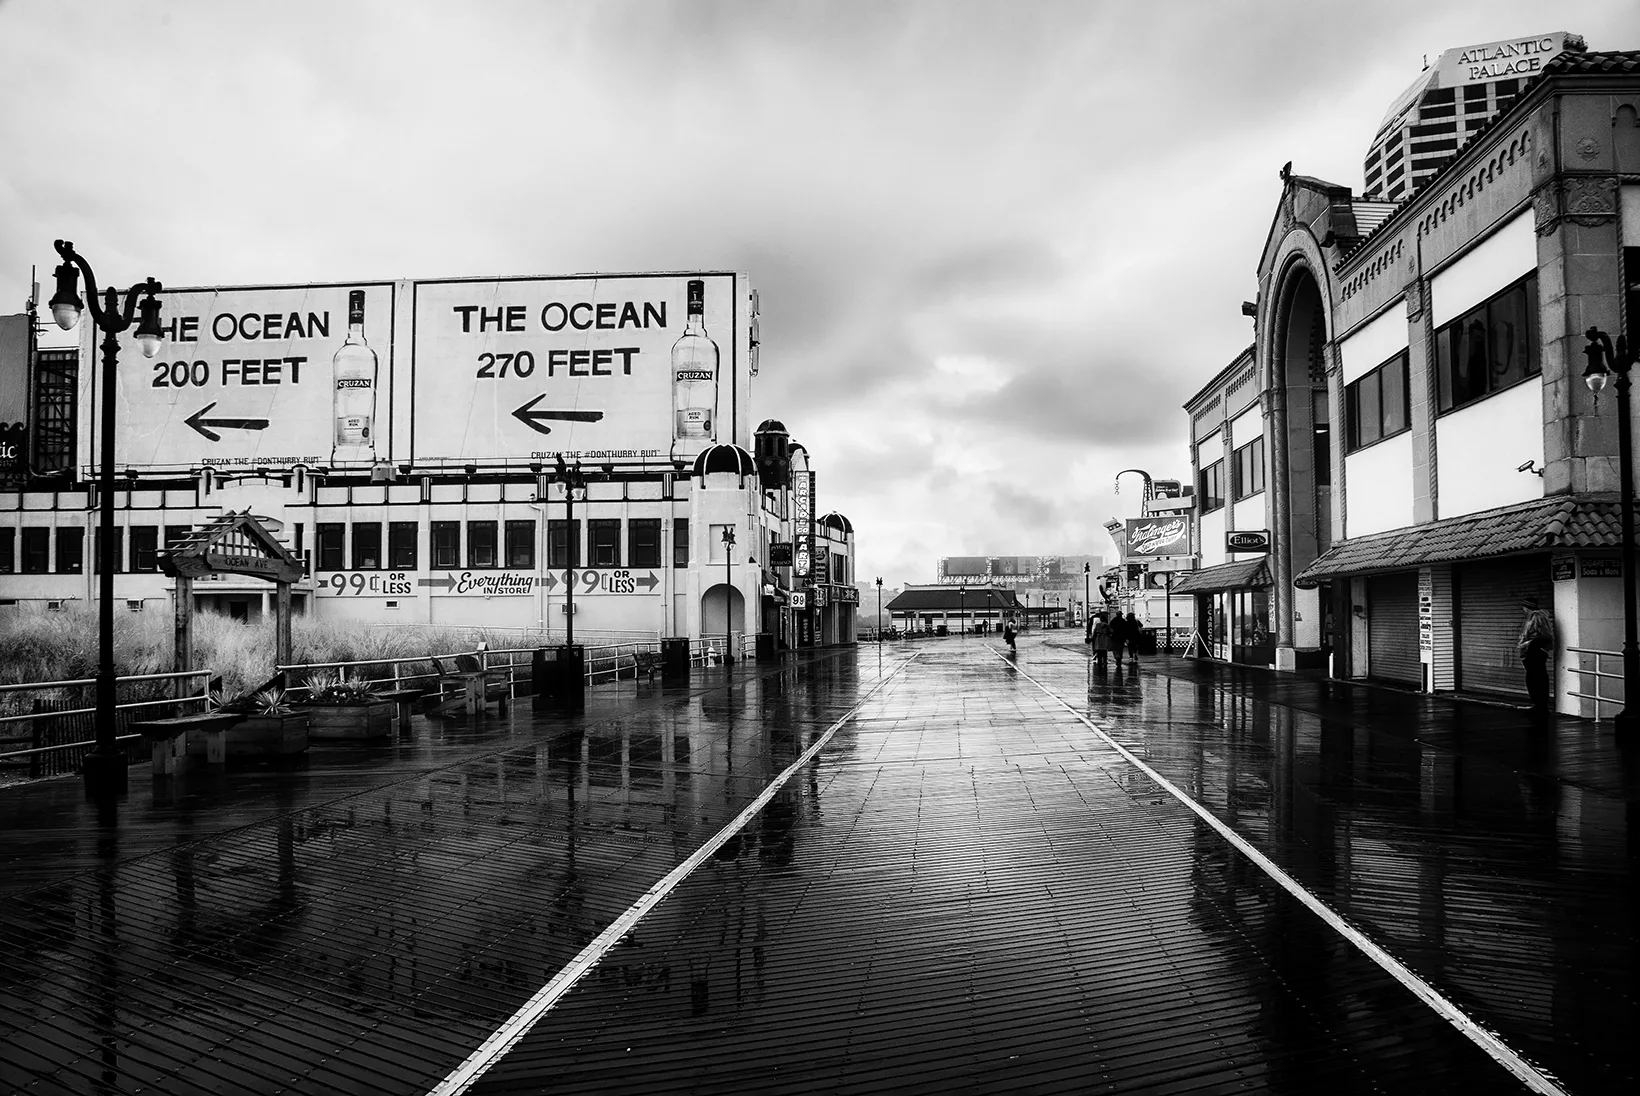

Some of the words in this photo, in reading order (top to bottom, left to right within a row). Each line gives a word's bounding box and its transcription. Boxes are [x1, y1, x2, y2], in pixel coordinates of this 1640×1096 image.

[1457, 37, 1553, 65] ATLANTIC
[1469, 57, 1541, 80] PALACE
[453, 305, 526, 332] THE
[541, 301, 667, 332] OCEAN
[213, 311, 329, 341] OCEAN
[476, 350, 534, 379] 270
[548, 347, 640, 377] FEET
[152, 360, 210, 387] 200
[222, 356, 308, 386] FEET
[678, 371, 711, 380] CRUZAN
[338, 380, 371, 388] CRUZAN
[566, 451, 581, 459] THE
[584, 450, 637, 458] #DONTHURRY
[234, 457, 249, 465] THE
[1233, 536, 1265, 544] Elliot's
[798, 535, 808, 576] KARTS
[225, 558, 249, 567] OCEAN
[614, 570, 630, 578] OR
[383, 582, 411, 594] LESS
[457, 571, 533, 594] Everything
[609, 579, 635, 593] LESS
[483, 586, 493, 594] IN
[498, 586, 527, 594] STORE
[793, 595, 804, 605] 99
